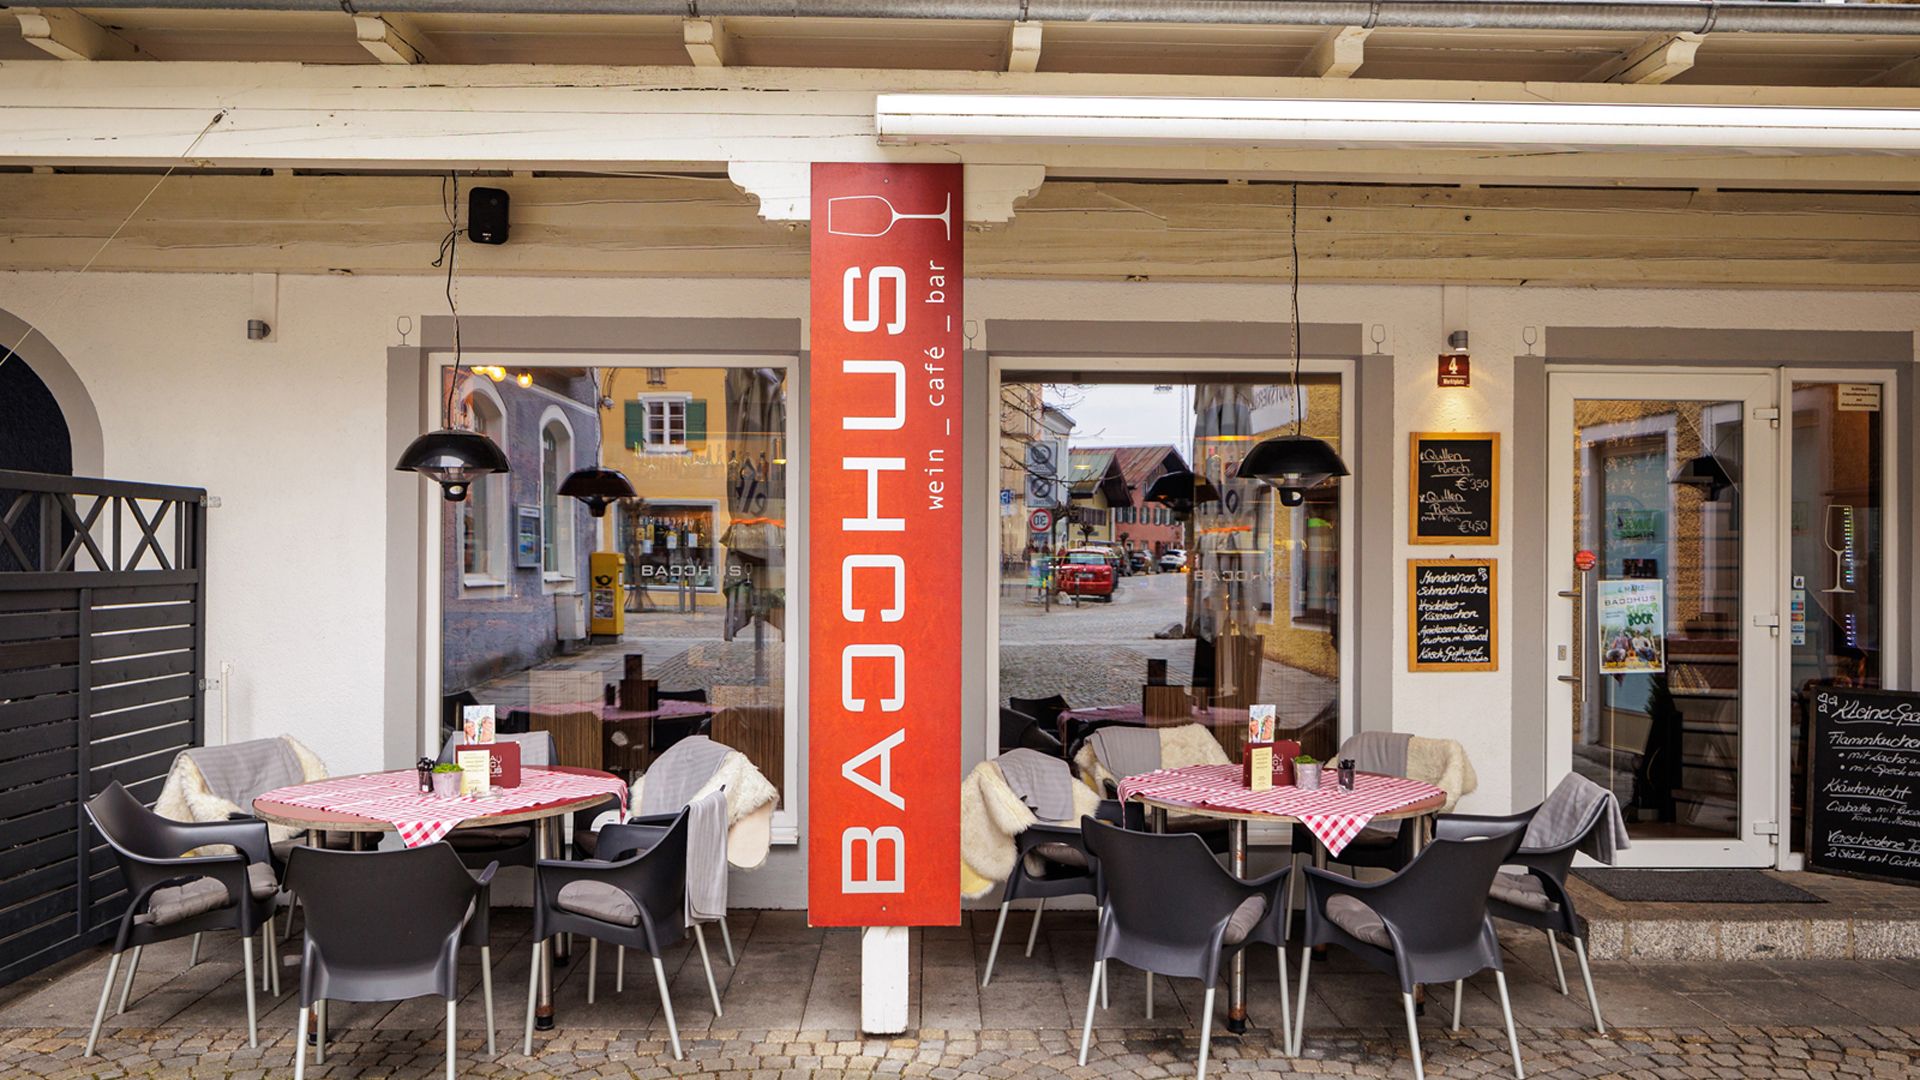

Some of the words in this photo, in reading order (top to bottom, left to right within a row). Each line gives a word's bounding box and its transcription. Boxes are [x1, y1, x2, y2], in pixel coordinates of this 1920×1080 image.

[925, 260, 945, 303] bar
[924, 346, 945, 407] café
[1448, 357, 1458, 374] 4
[924, 449, 944, 510] wein
[1831, 700, 1891, 719] Kleine
